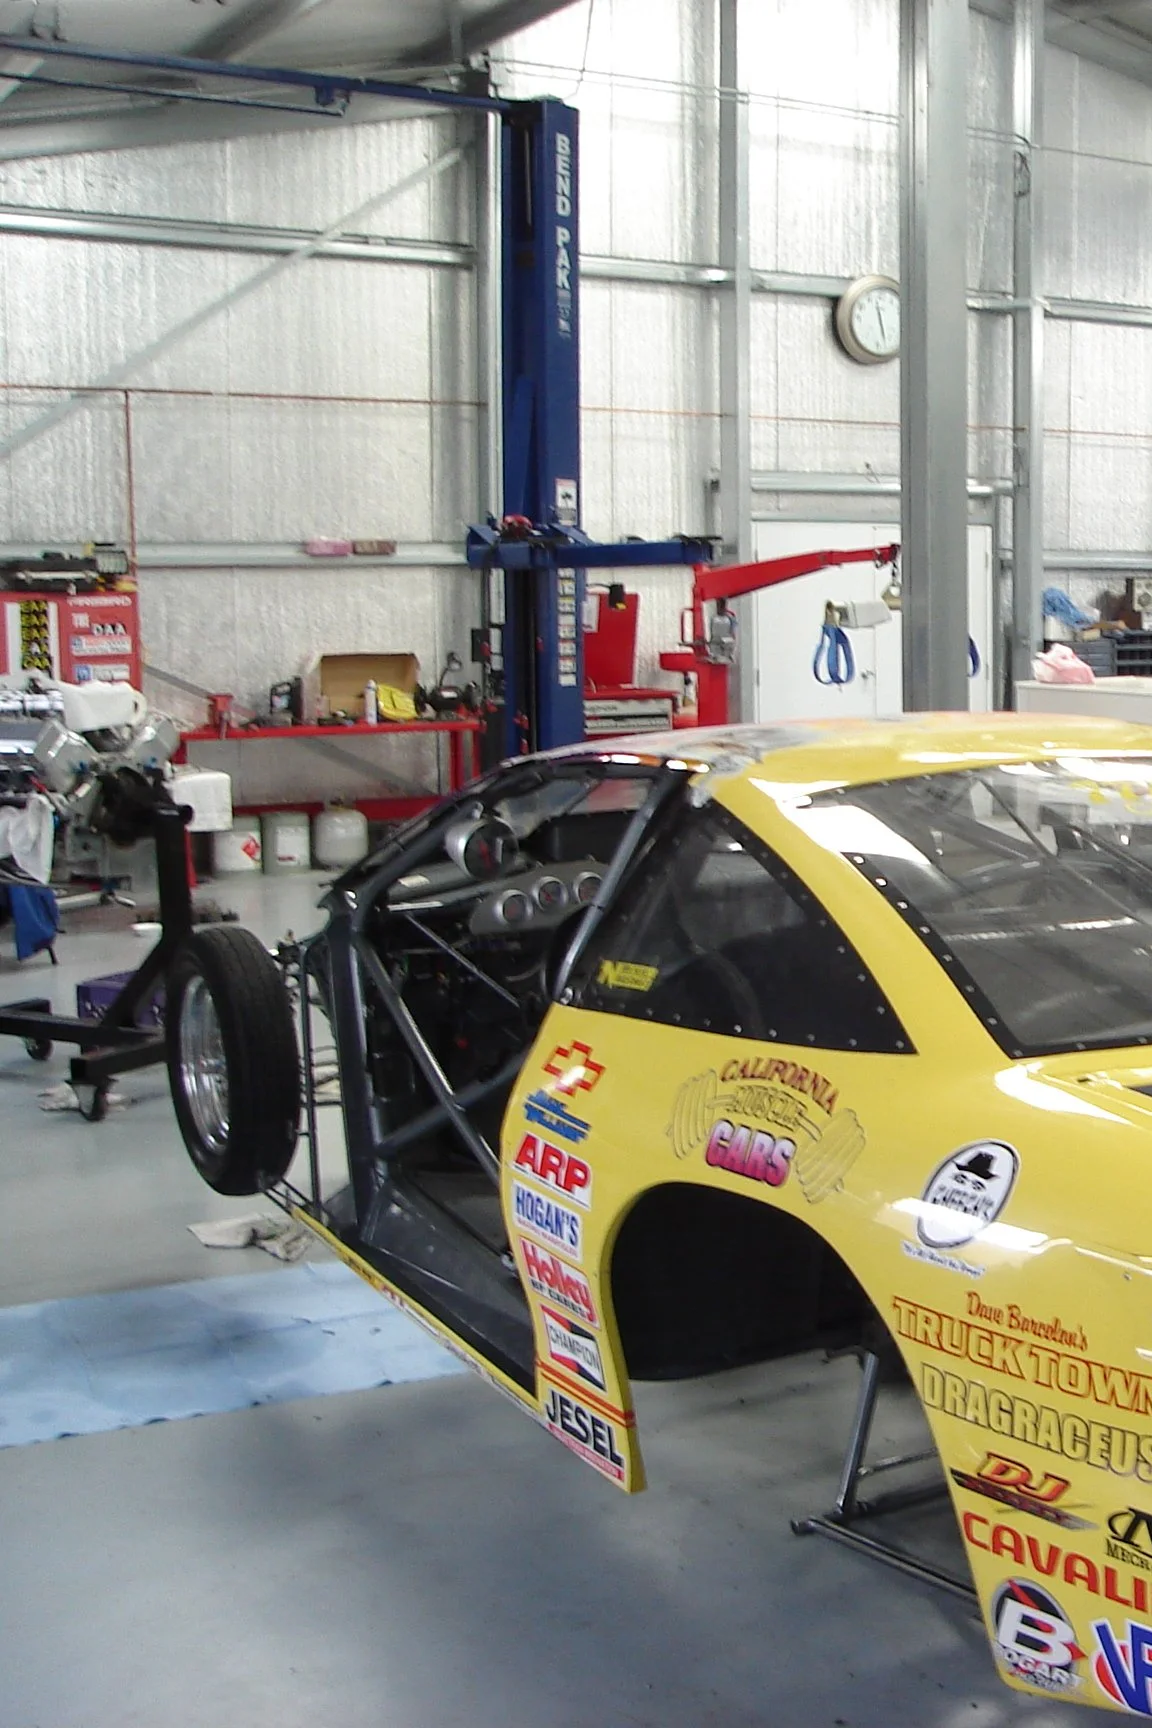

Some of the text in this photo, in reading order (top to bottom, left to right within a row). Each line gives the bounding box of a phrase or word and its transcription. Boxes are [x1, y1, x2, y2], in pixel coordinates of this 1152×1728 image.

[555, 132, 572, 218] BEND
[719, 1056, 840, 1117] CALIFORNIA
[514, 1132, 592, 1195] ARP
[516, 1184, 580, 1247] HOGAN'S
[966, 1290, 1004, 1325] Dave
[549, 1323, 602, 1373] CHAMPION
[545, 1388, 623, 1467] JESEL
[976, 1451, 1072, 1503] DJ
